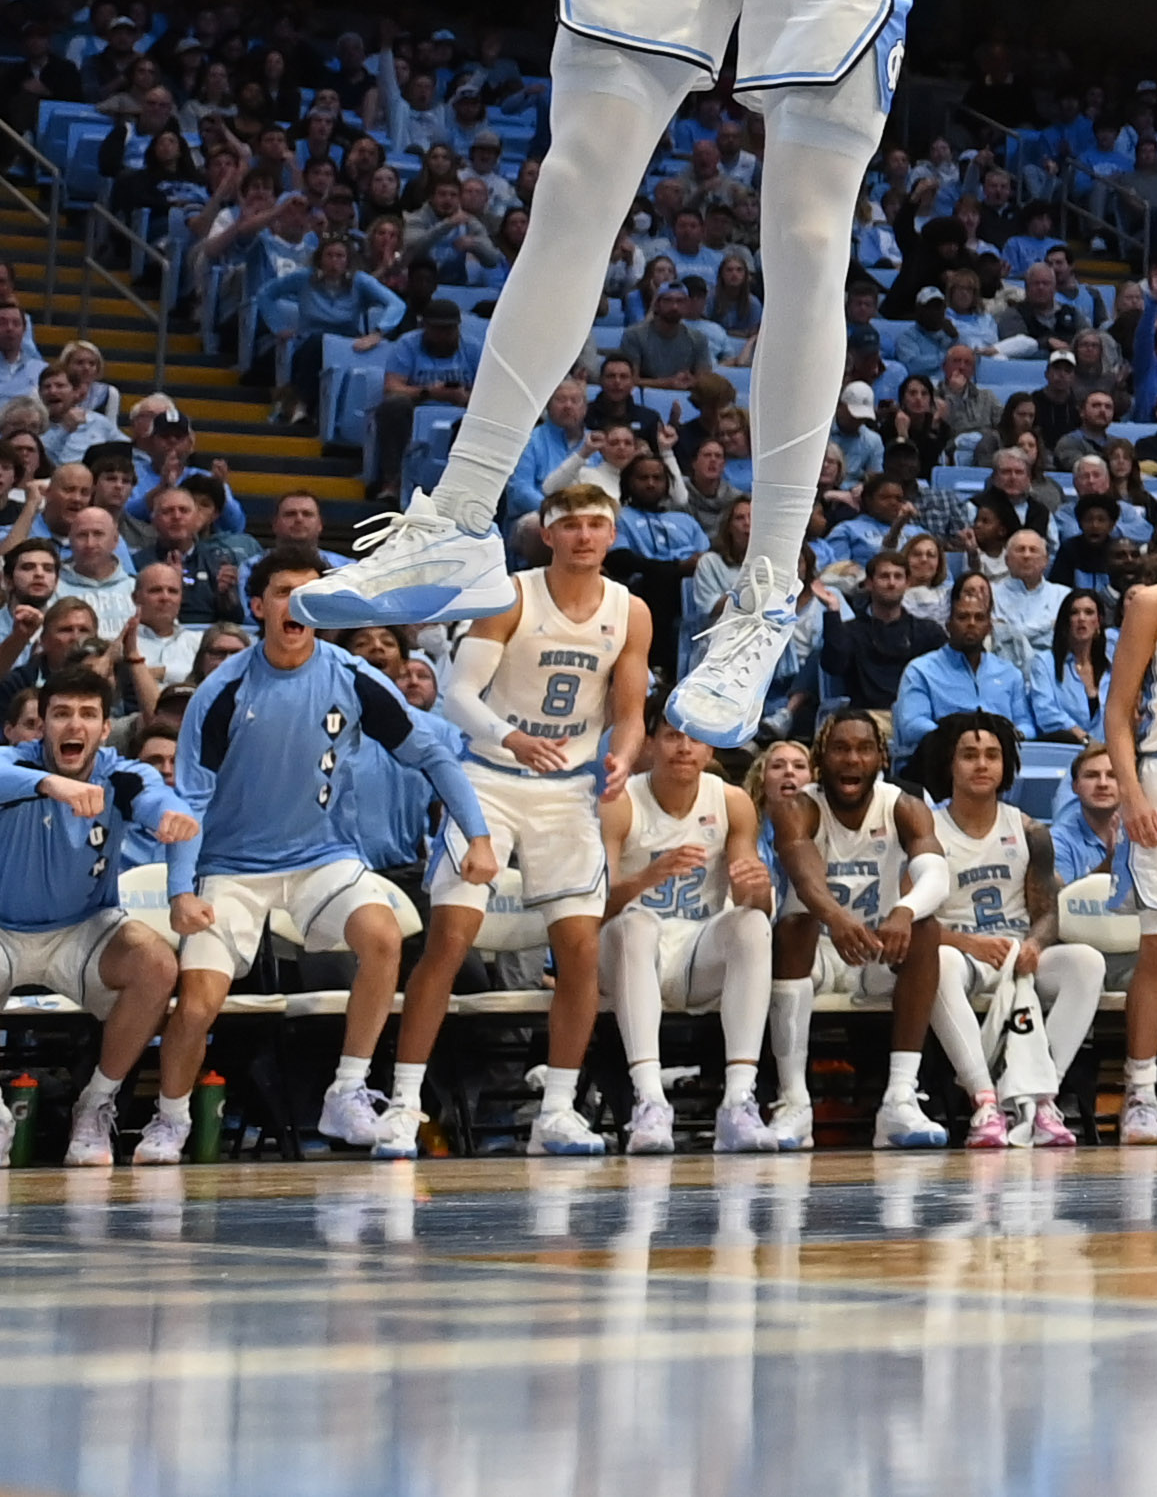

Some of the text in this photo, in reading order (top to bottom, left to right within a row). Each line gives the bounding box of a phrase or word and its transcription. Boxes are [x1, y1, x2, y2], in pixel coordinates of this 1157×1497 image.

[538, 650, 599, 672] NORTH
[541, 672, 581, 717] 8
[957, 864, 1012, 889] NORTH
[970, 885, 1007, 927] 2
